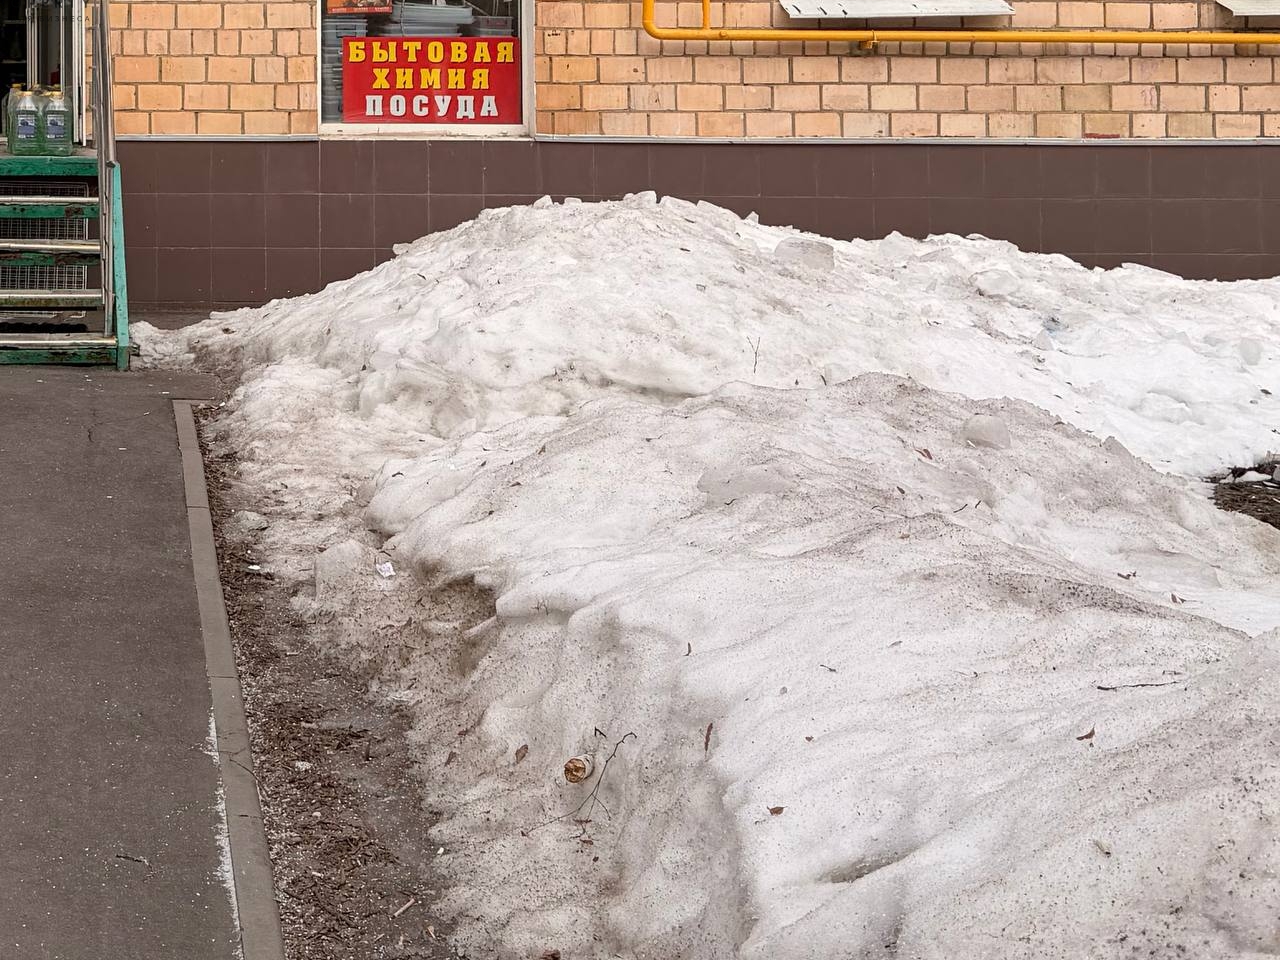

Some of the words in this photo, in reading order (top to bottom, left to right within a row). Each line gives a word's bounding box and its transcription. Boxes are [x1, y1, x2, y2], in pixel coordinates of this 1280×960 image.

[349, 42, 514, 63] БЫТОВАЯ
[372, 68, 490, 90] ХИМИЯ
[365, 95, 499, 119] ПОСУДА
